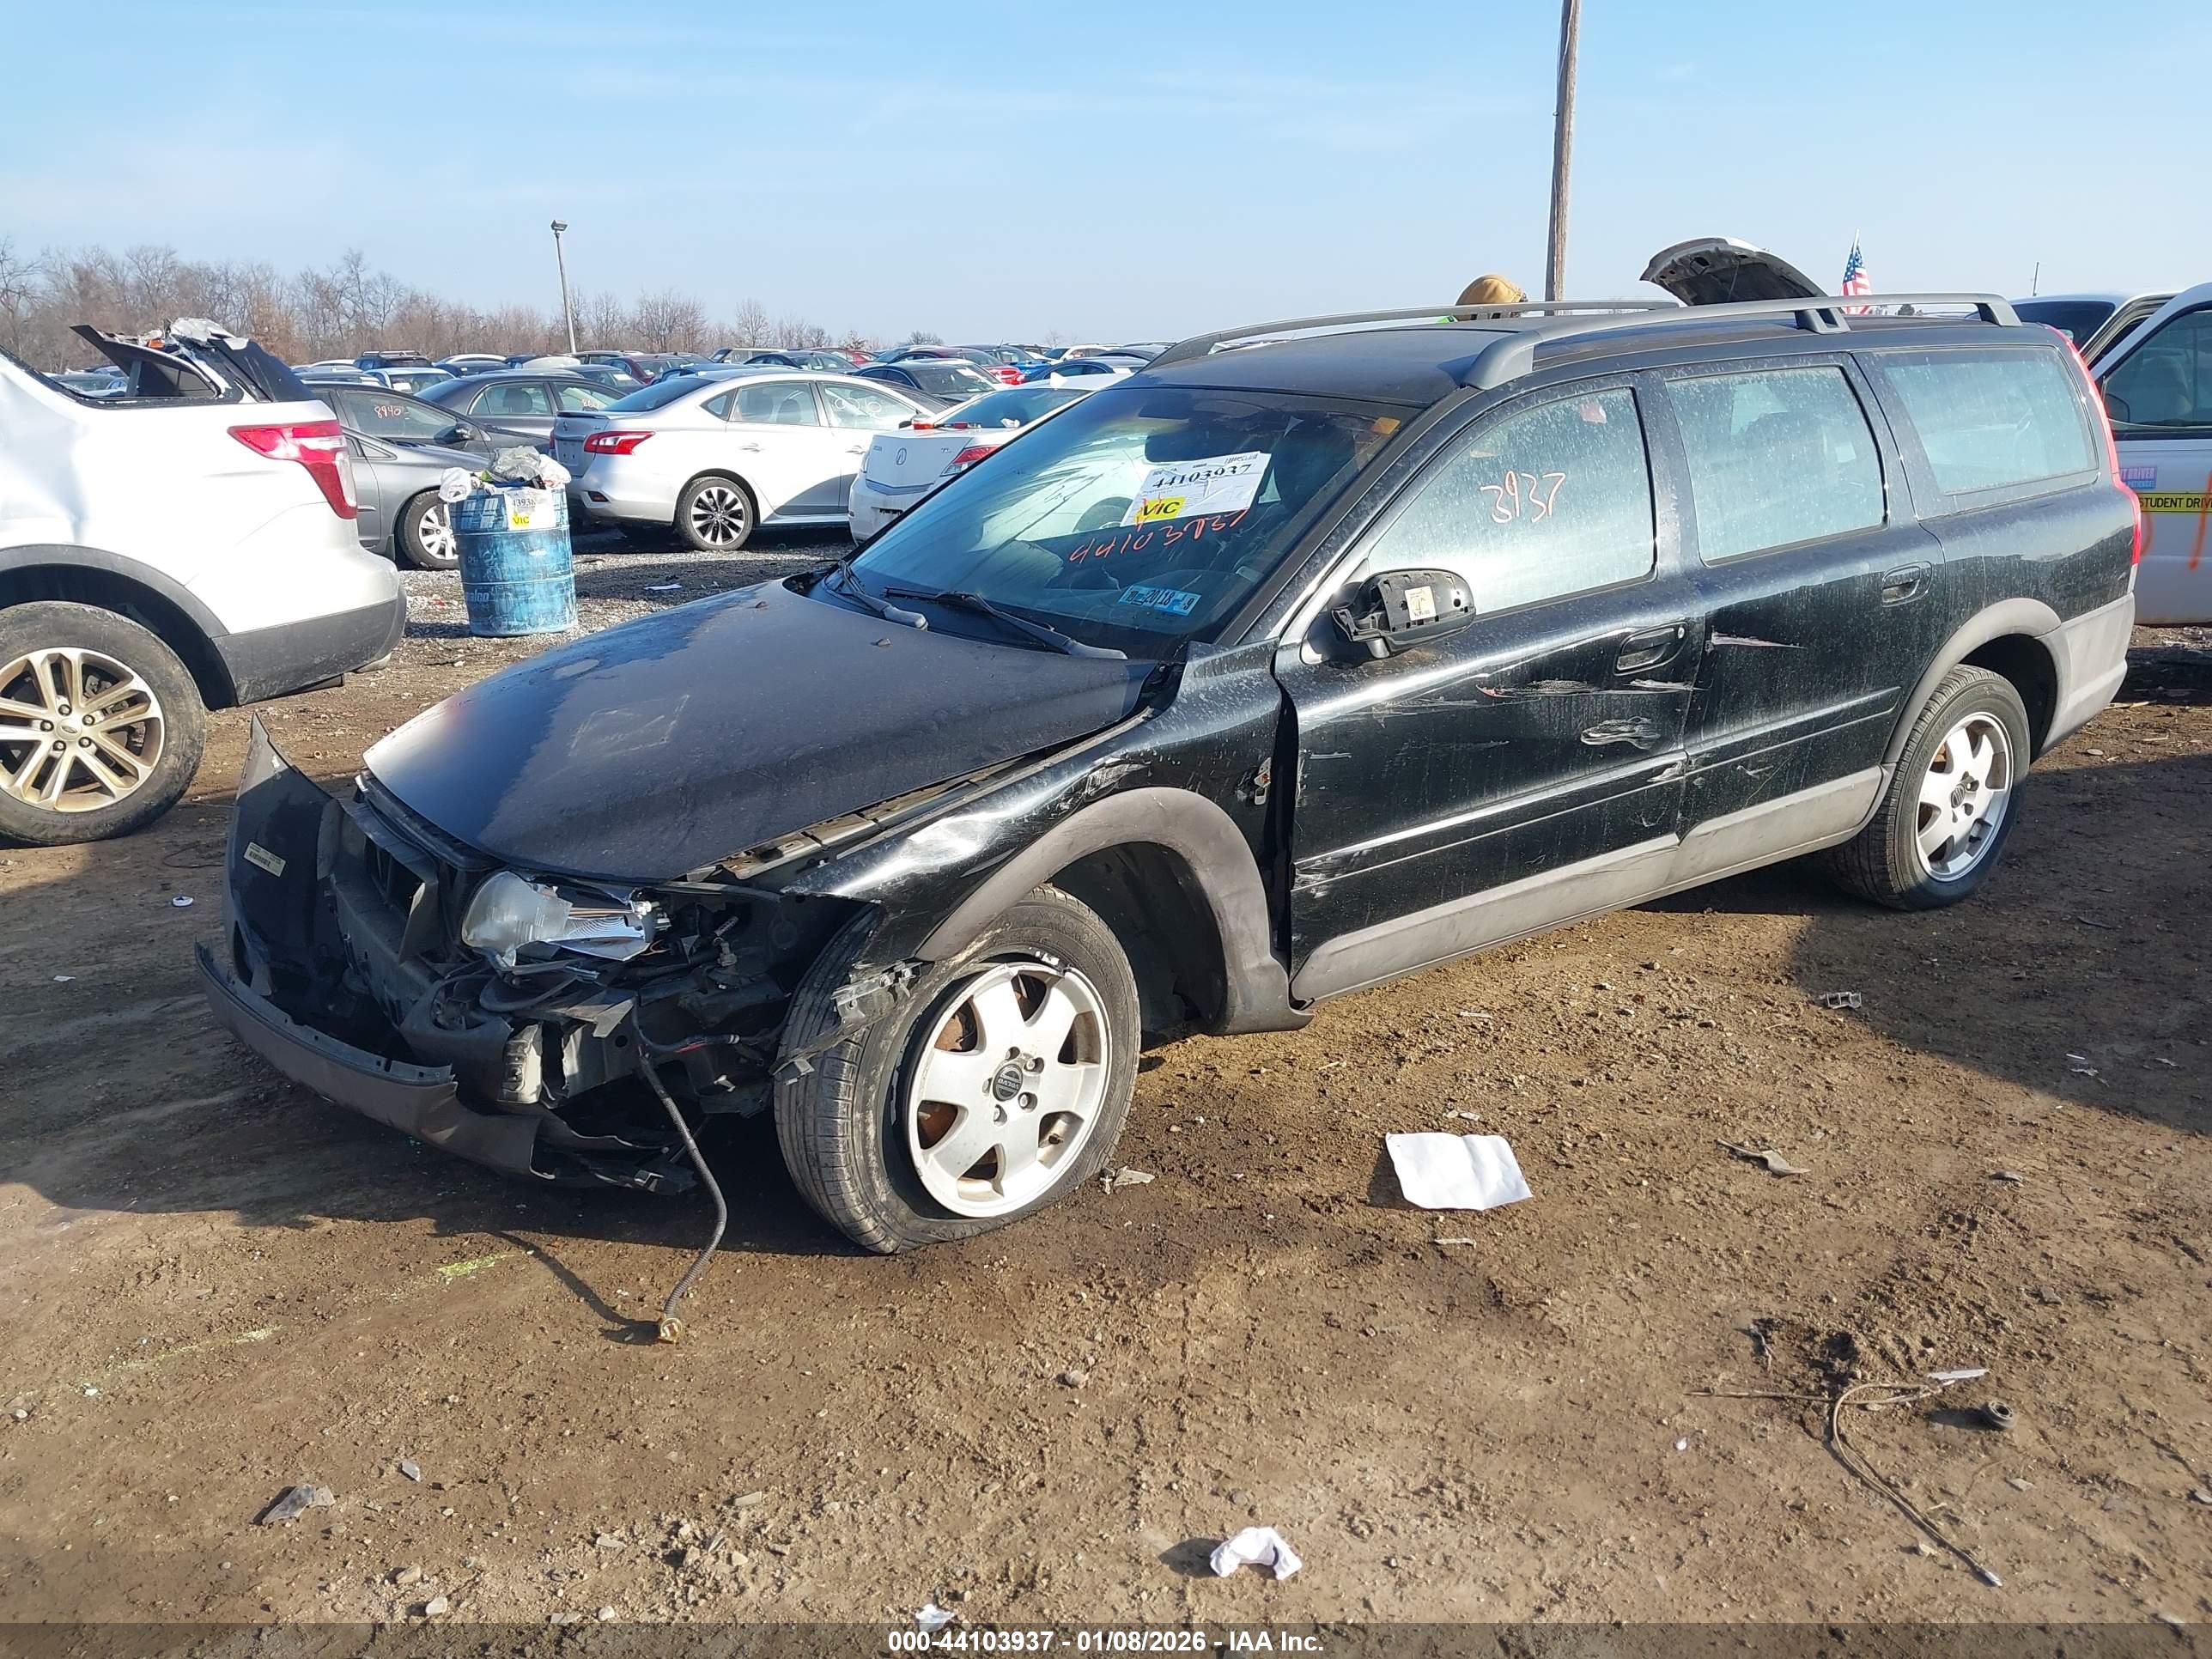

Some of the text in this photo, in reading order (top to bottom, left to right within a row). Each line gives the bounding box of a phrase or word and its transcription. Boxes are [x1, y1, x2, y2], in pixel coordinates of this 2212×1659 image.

[1152, 464, 1252, 489] 44103937
[1480, 471, 1566, 524] 3937
[2140, 497, 2212, 508] STUDENT DRIV
[1143, 501, 1181, 517] VIC
[512, 516, 530, 525] VIC
